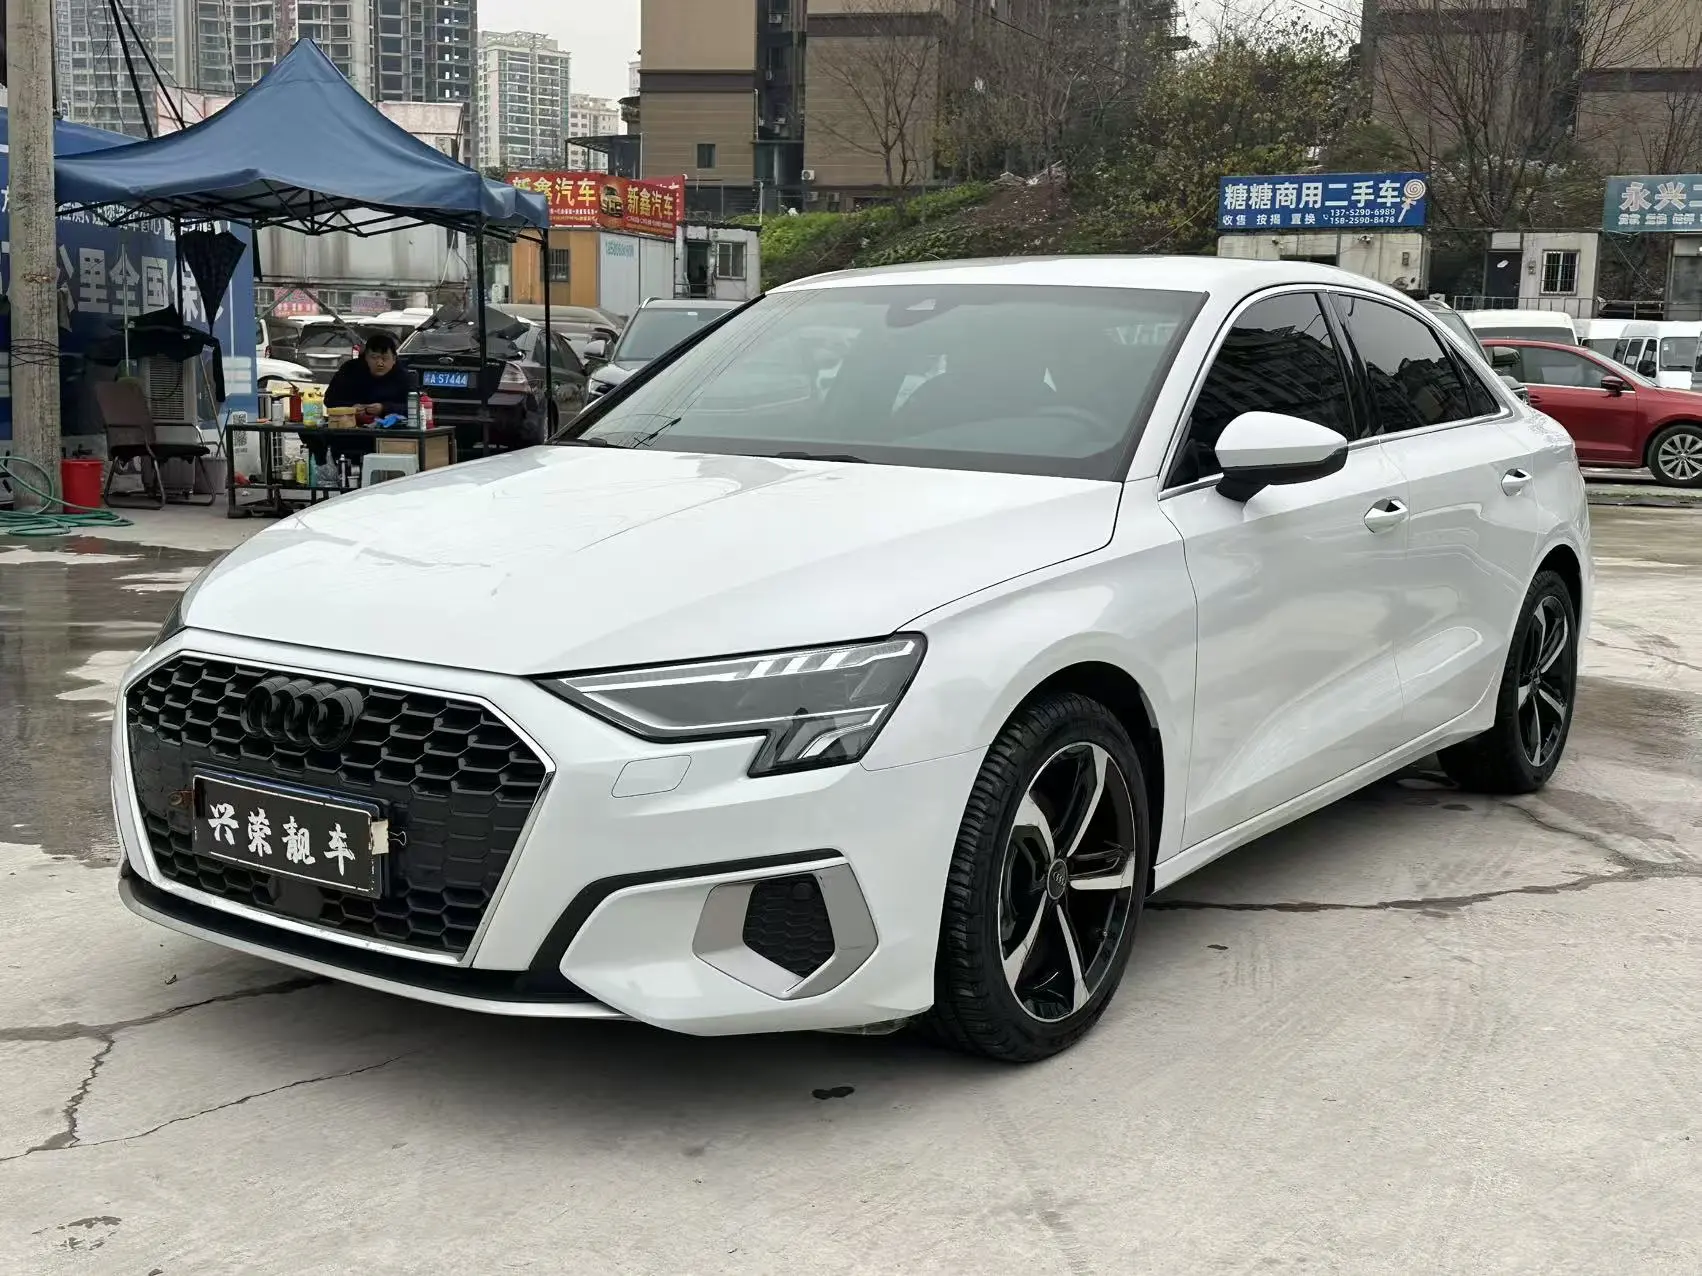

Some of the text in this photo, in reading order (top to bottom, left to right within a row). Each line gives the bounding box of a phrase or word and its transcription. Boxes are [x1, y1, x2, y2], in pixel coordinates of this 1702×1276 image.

[627, 184, 674, 221] 新鑫汽车
[1224, 180, 1401, 210] 糖糖商用二手车
[208, 803, 356, 876] 兴荣靓车
